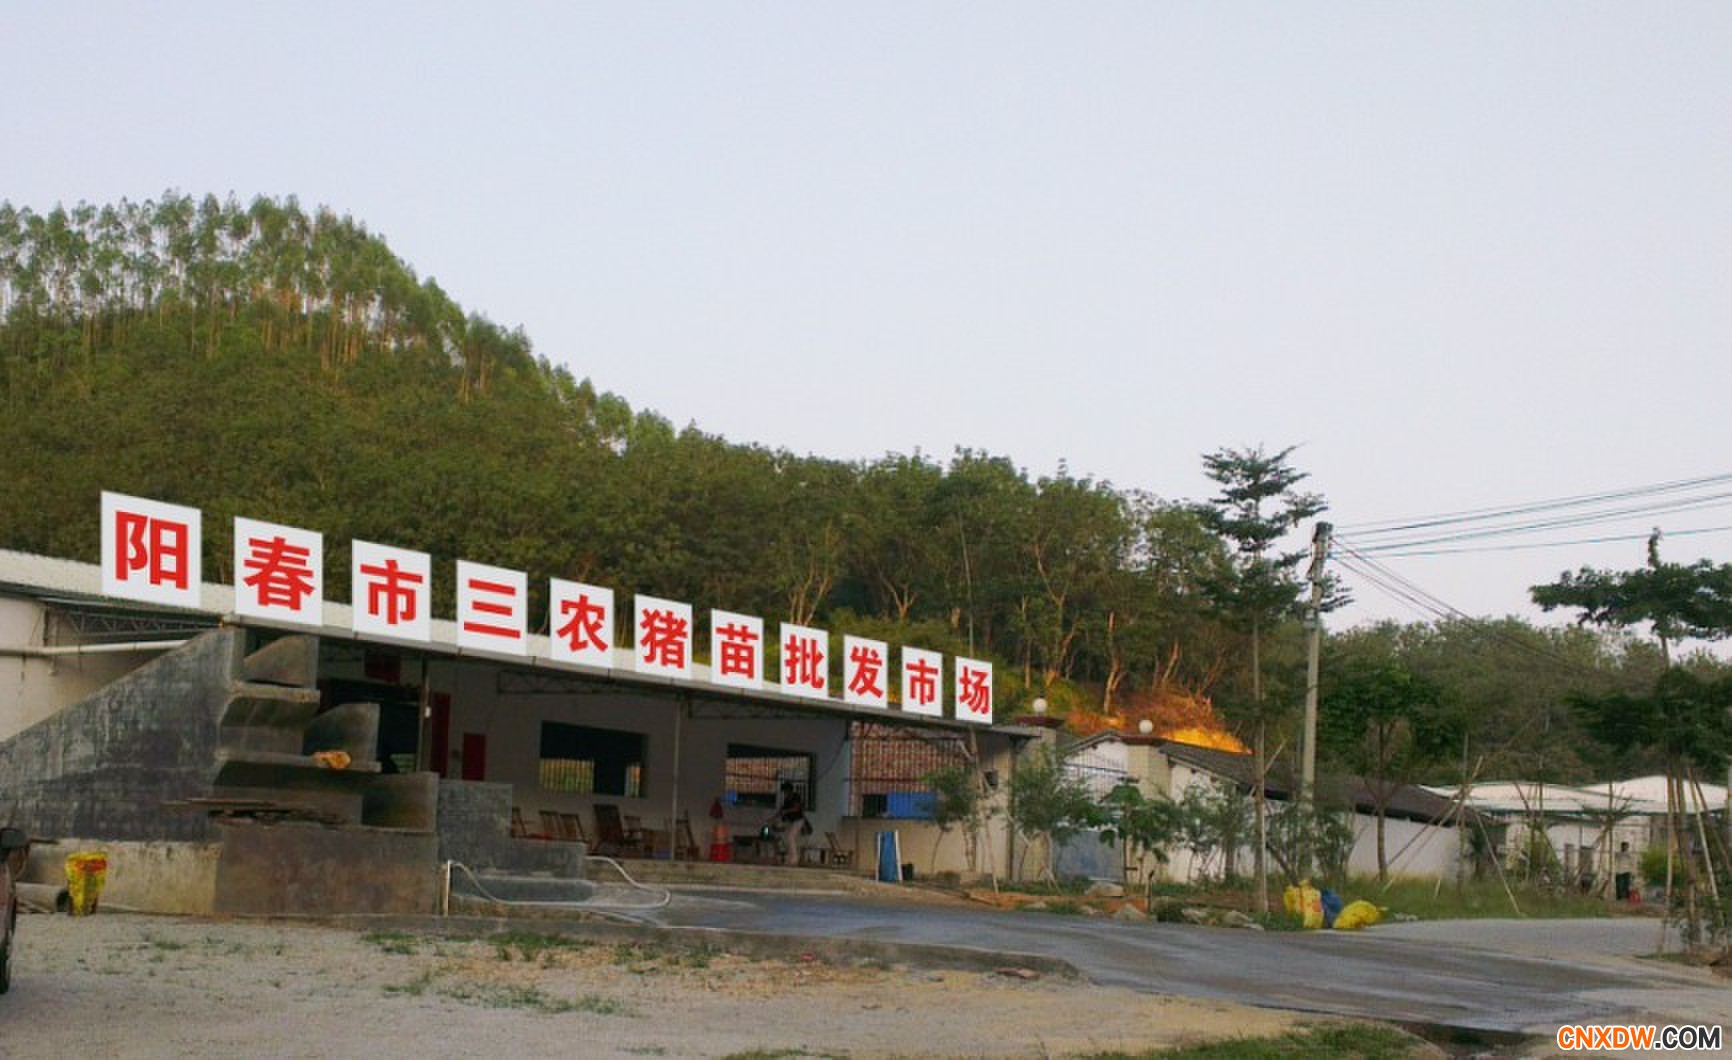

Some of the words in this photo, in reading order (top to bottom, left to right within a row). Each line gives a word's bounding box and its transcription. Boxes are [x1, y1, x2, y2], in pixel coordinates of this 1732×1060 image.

[115, 511, 990, 715] 阳春市三农猪苗批发市场
